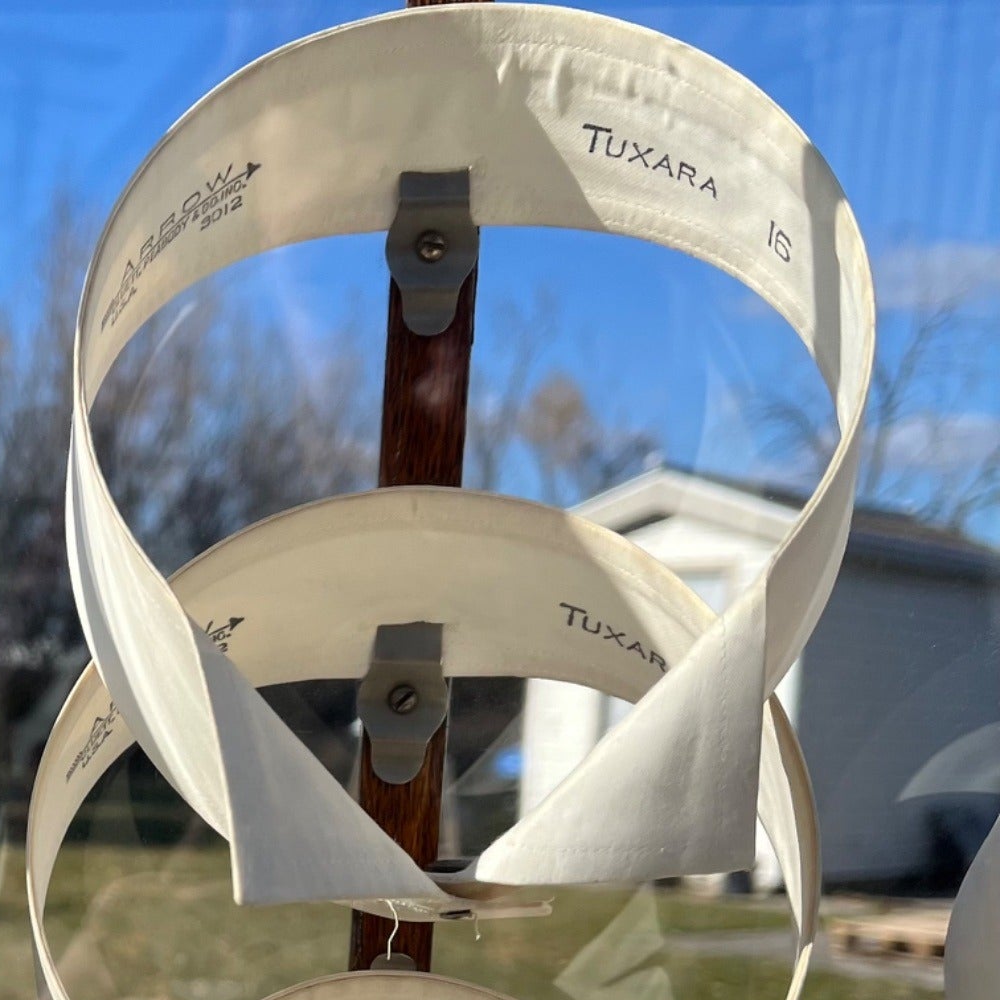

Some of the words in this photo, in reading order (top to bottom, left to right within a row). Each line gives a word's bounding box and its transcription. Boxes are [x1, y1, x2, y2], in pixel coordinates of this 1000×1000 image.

[582, 122, 720, 201] TUXARA
[122, 163, 233, 284] ARROW
[767, 219, 793, 263] 16
[559, 602, 667, 673] TUXAR
